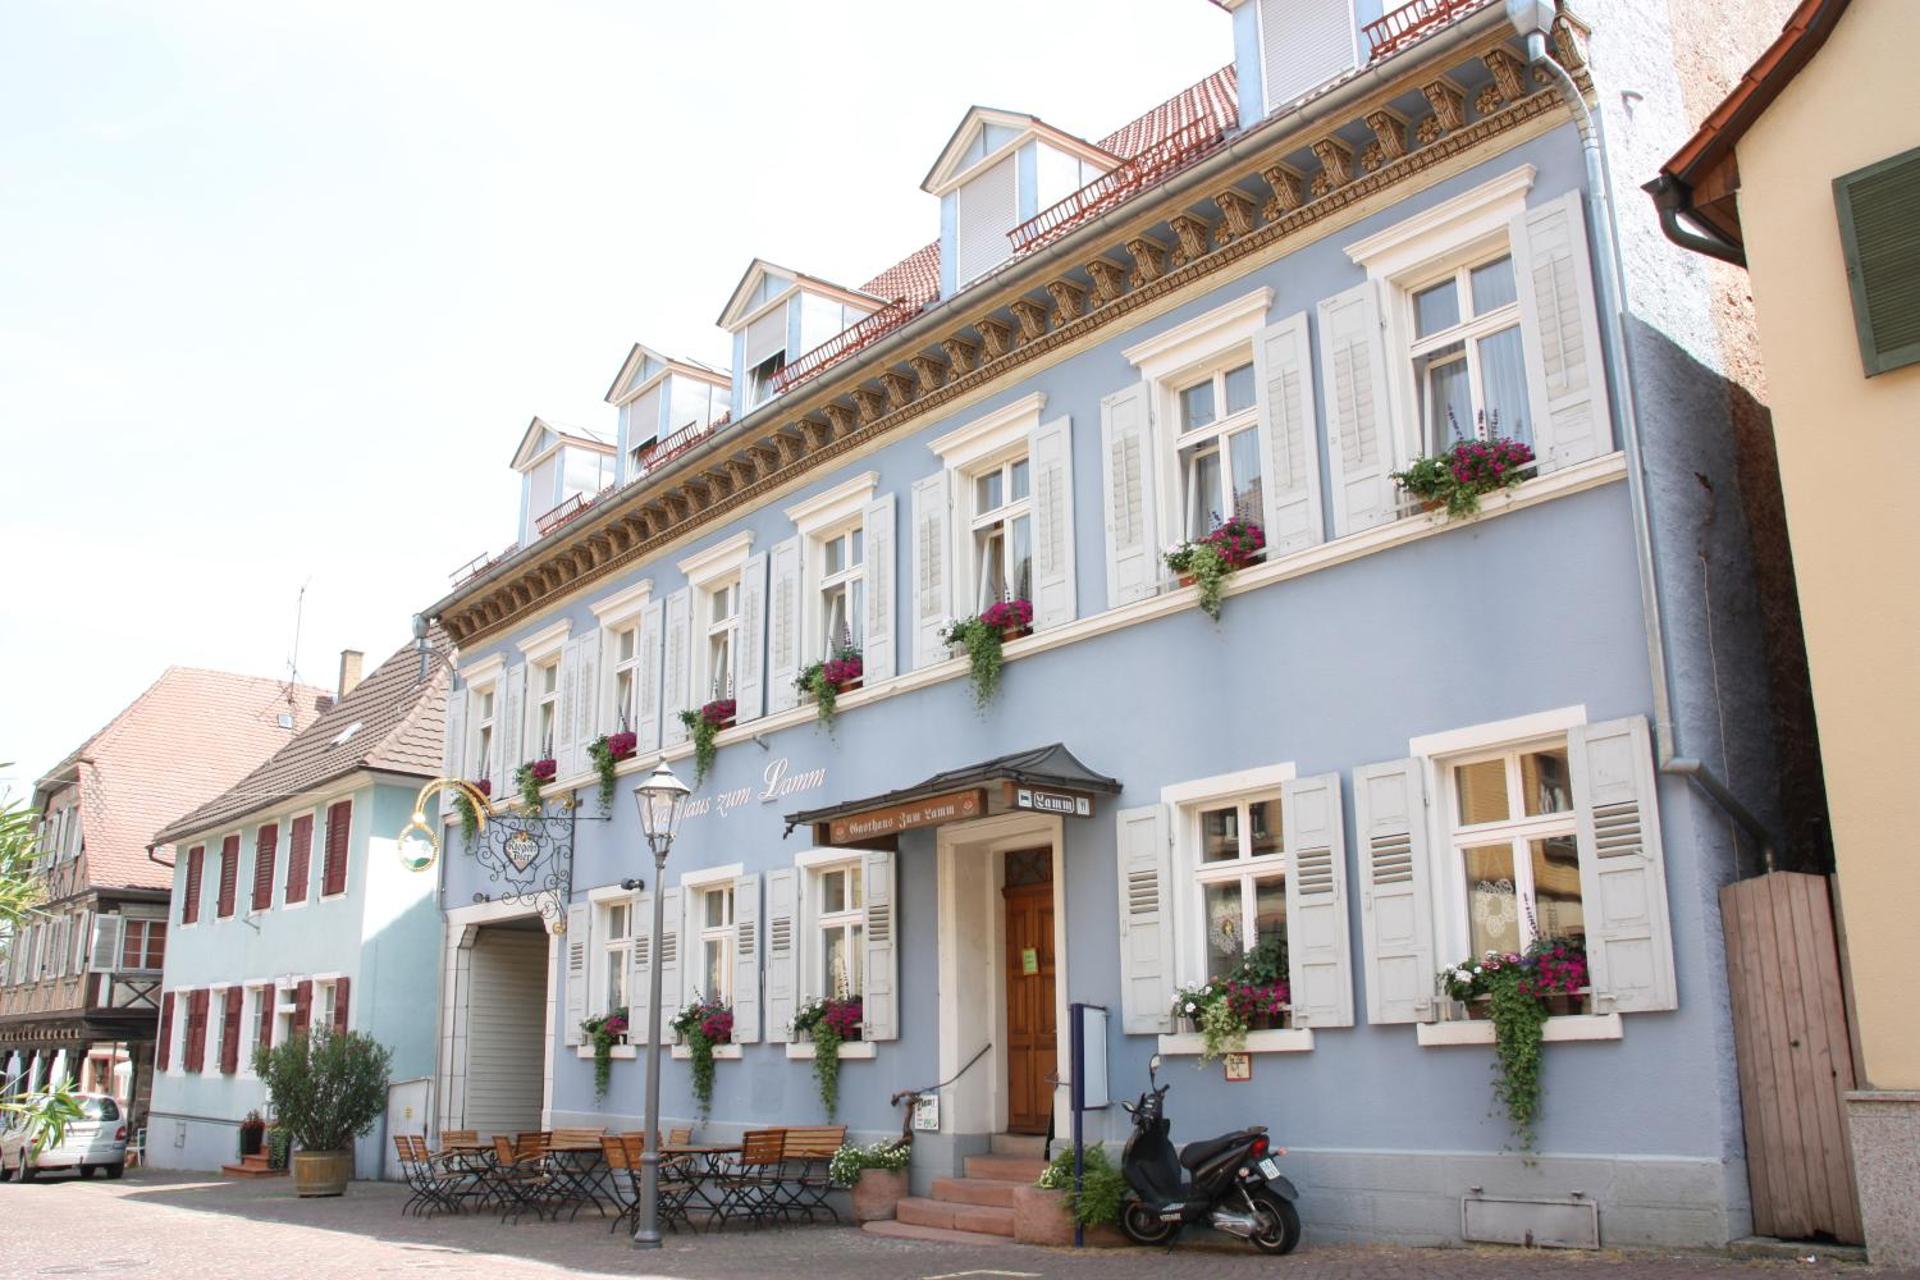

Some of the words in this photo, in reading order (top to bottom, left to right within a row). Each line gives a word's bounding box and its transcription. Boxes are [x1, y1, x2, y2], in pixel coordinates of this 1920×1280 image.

[717, 787, 751, 818] zum
[758, 757, 827, 801] Lamm
[1036, 793, 1073, 811] Lamm
[849, 817, 893, 835] Gasthaus
[924, 804, 955, 821] Lamm
